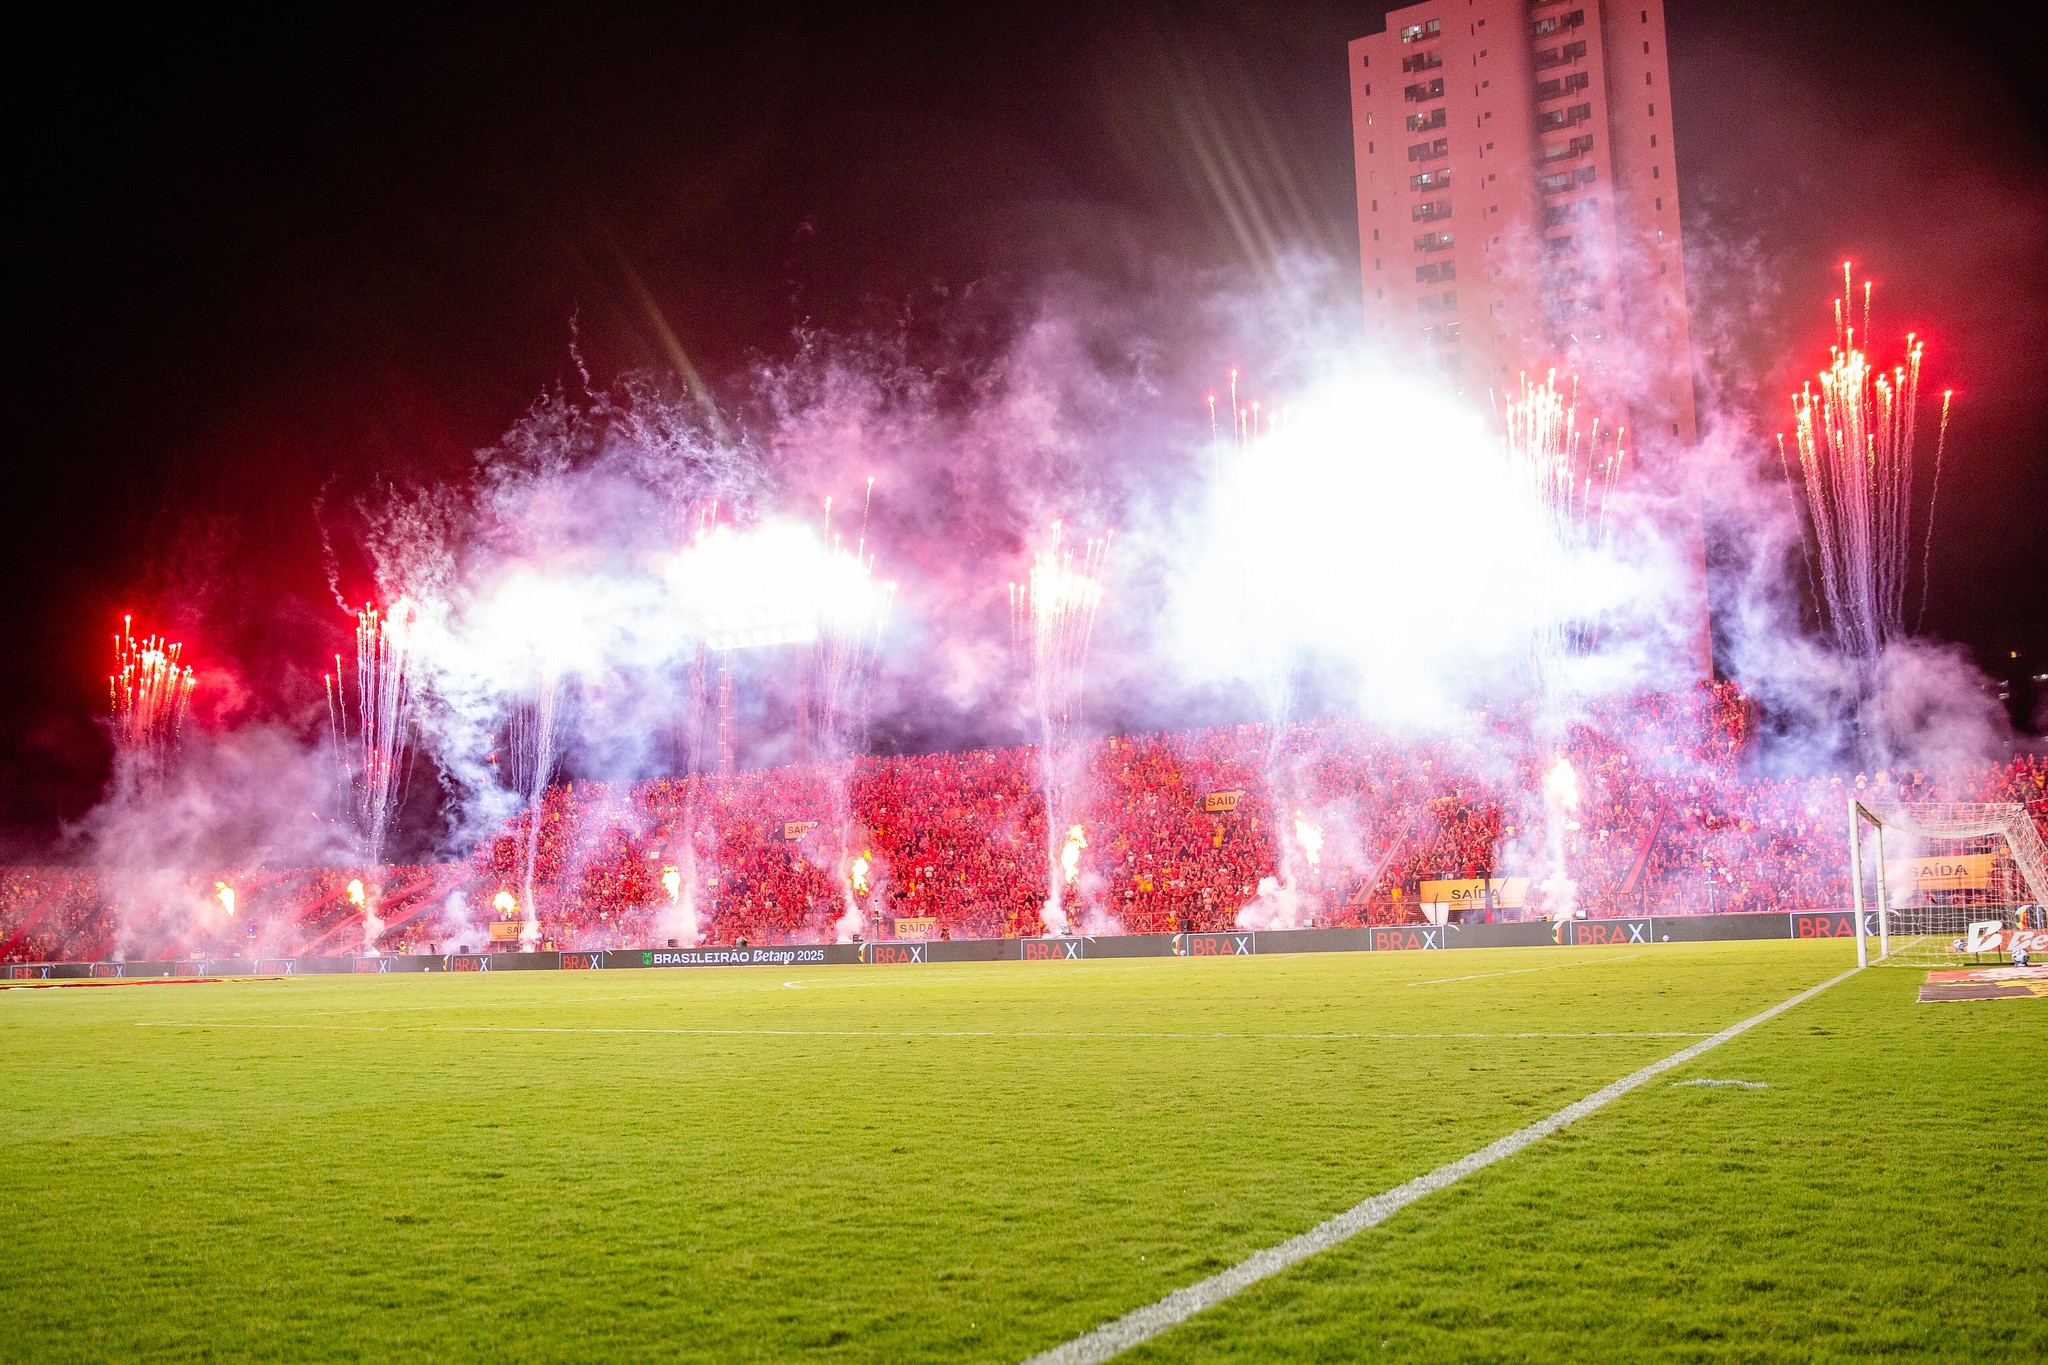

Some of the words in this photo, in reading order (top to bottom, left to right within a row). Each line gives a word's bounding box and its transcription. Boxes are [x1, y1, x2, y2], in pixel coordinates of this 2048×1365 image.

[1909, 862, 1968, 878] SAÍDA
[1451, 885, 1499, 900] SAÍDA
[1376, 930, 1438, 951] BRAX
[1577, 923, 1646, 945] BRAX
[1026, 942, 1078, 960] BRAX
[1193, 936, 1249, 956] BRAX
[563, 954, 600, 970] BRAX
[653, 949, 750, 965] BRASILEIRÃO
[752, 950, 795, 963] Betano
[797, 950, 825, 961] 2025
[875, 946, 922, 964] BRAX
[98, 965, 123, 978] BRAX
[355, 959, 387, 974] BRAX
[454, 957, 488, 972] BRAX
